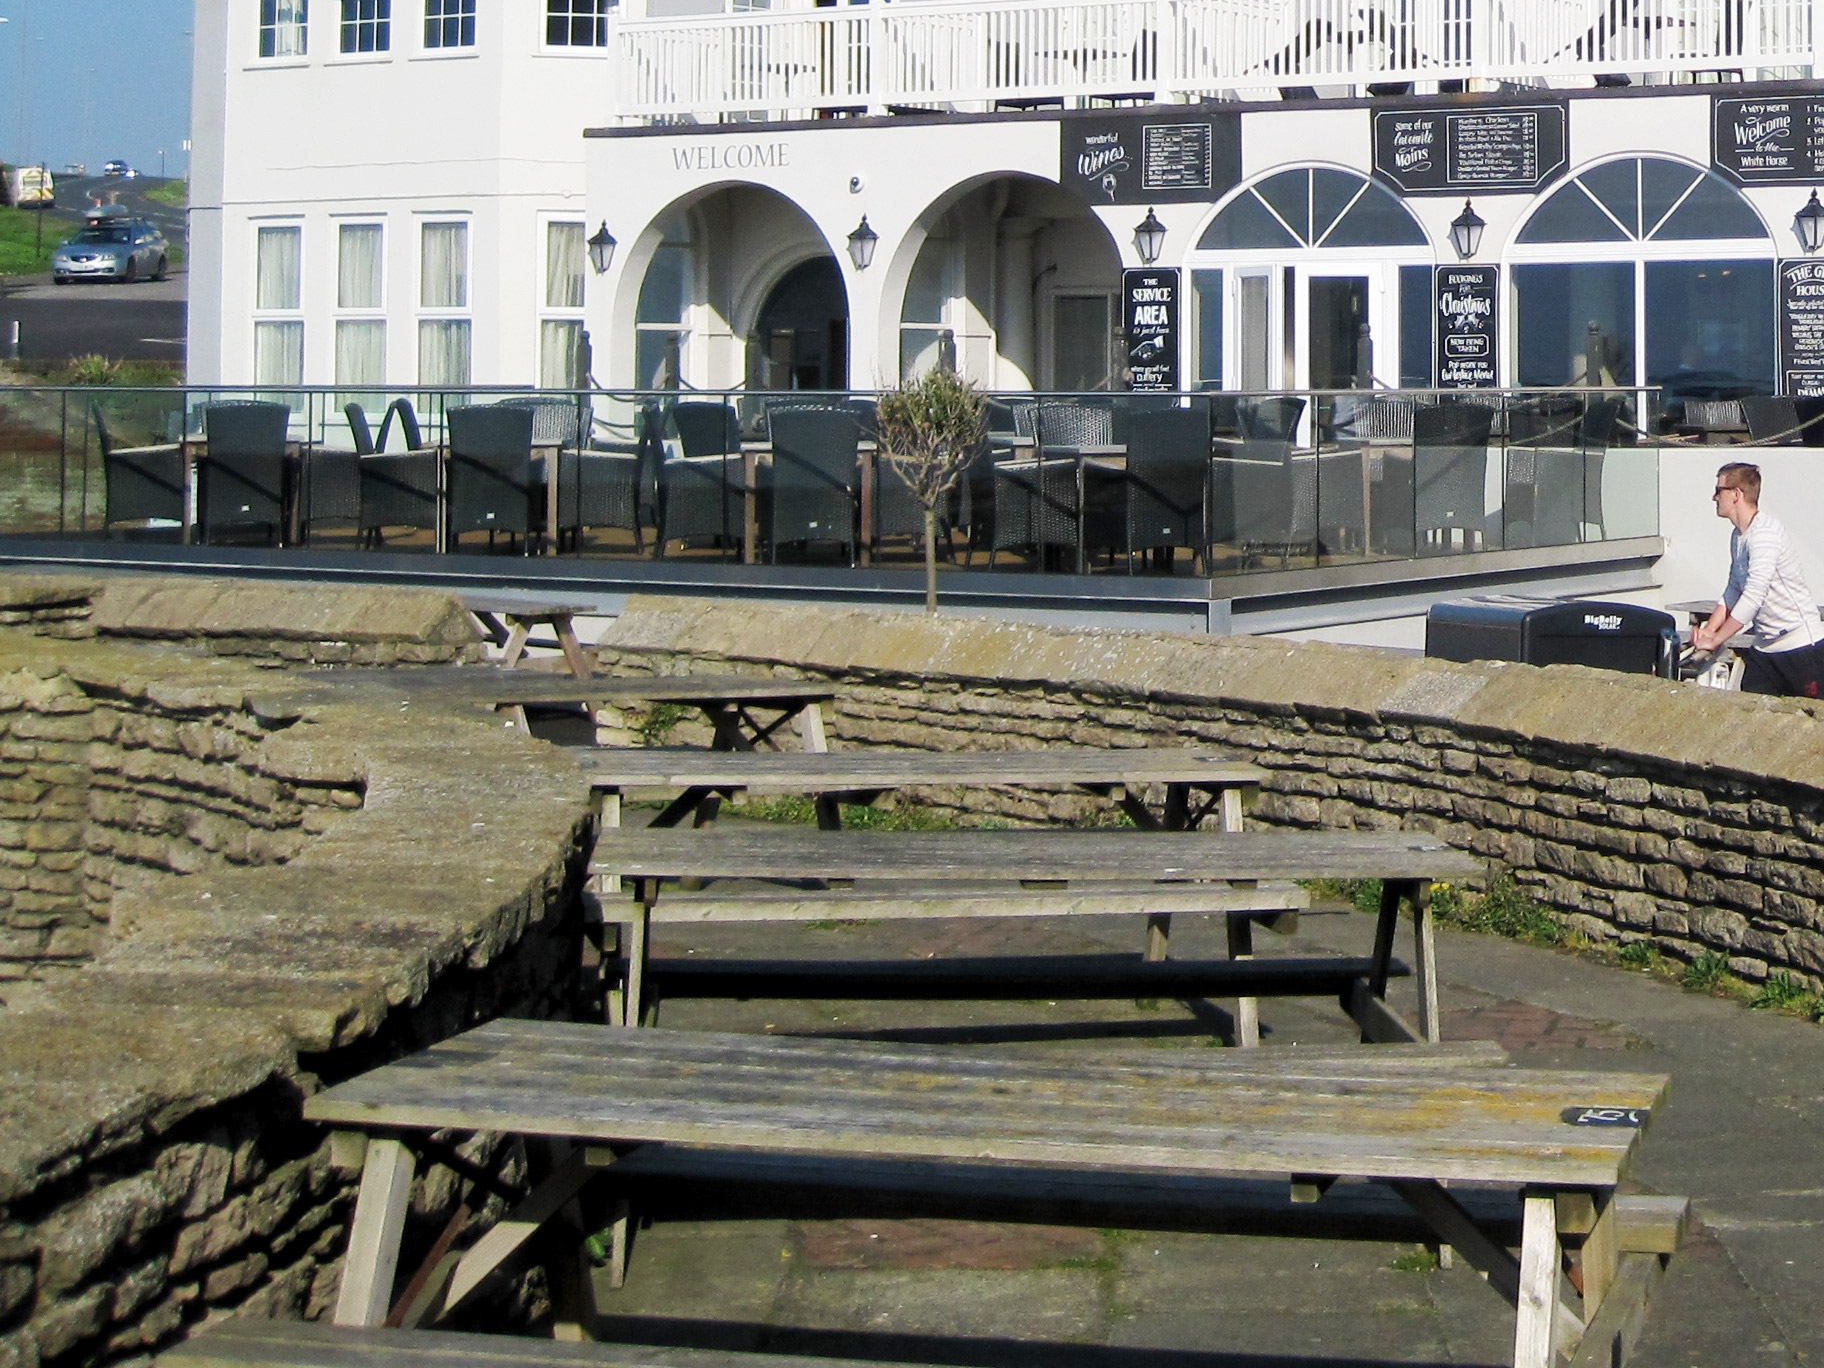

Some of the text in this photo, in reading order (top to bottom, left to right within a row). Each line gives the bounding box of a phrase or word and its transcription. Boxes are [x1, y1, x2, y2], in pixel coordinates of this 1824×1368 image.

[1734, 116, 1791, 145] Welcome
[672, 142, 791, 170] WELCOME
[1395, 147, 1429, 167] Mains
[1741, 155, 1788, 166] White Horse
[1787, 265, 1812, 283] THE
[1132, 288, 1171, 302] SERVICE
[1440, 292, 1491, 316] Christmas
[1134, 305, 1169, 325] AREA
[1584, 614, 1623, 626] BigBelly
